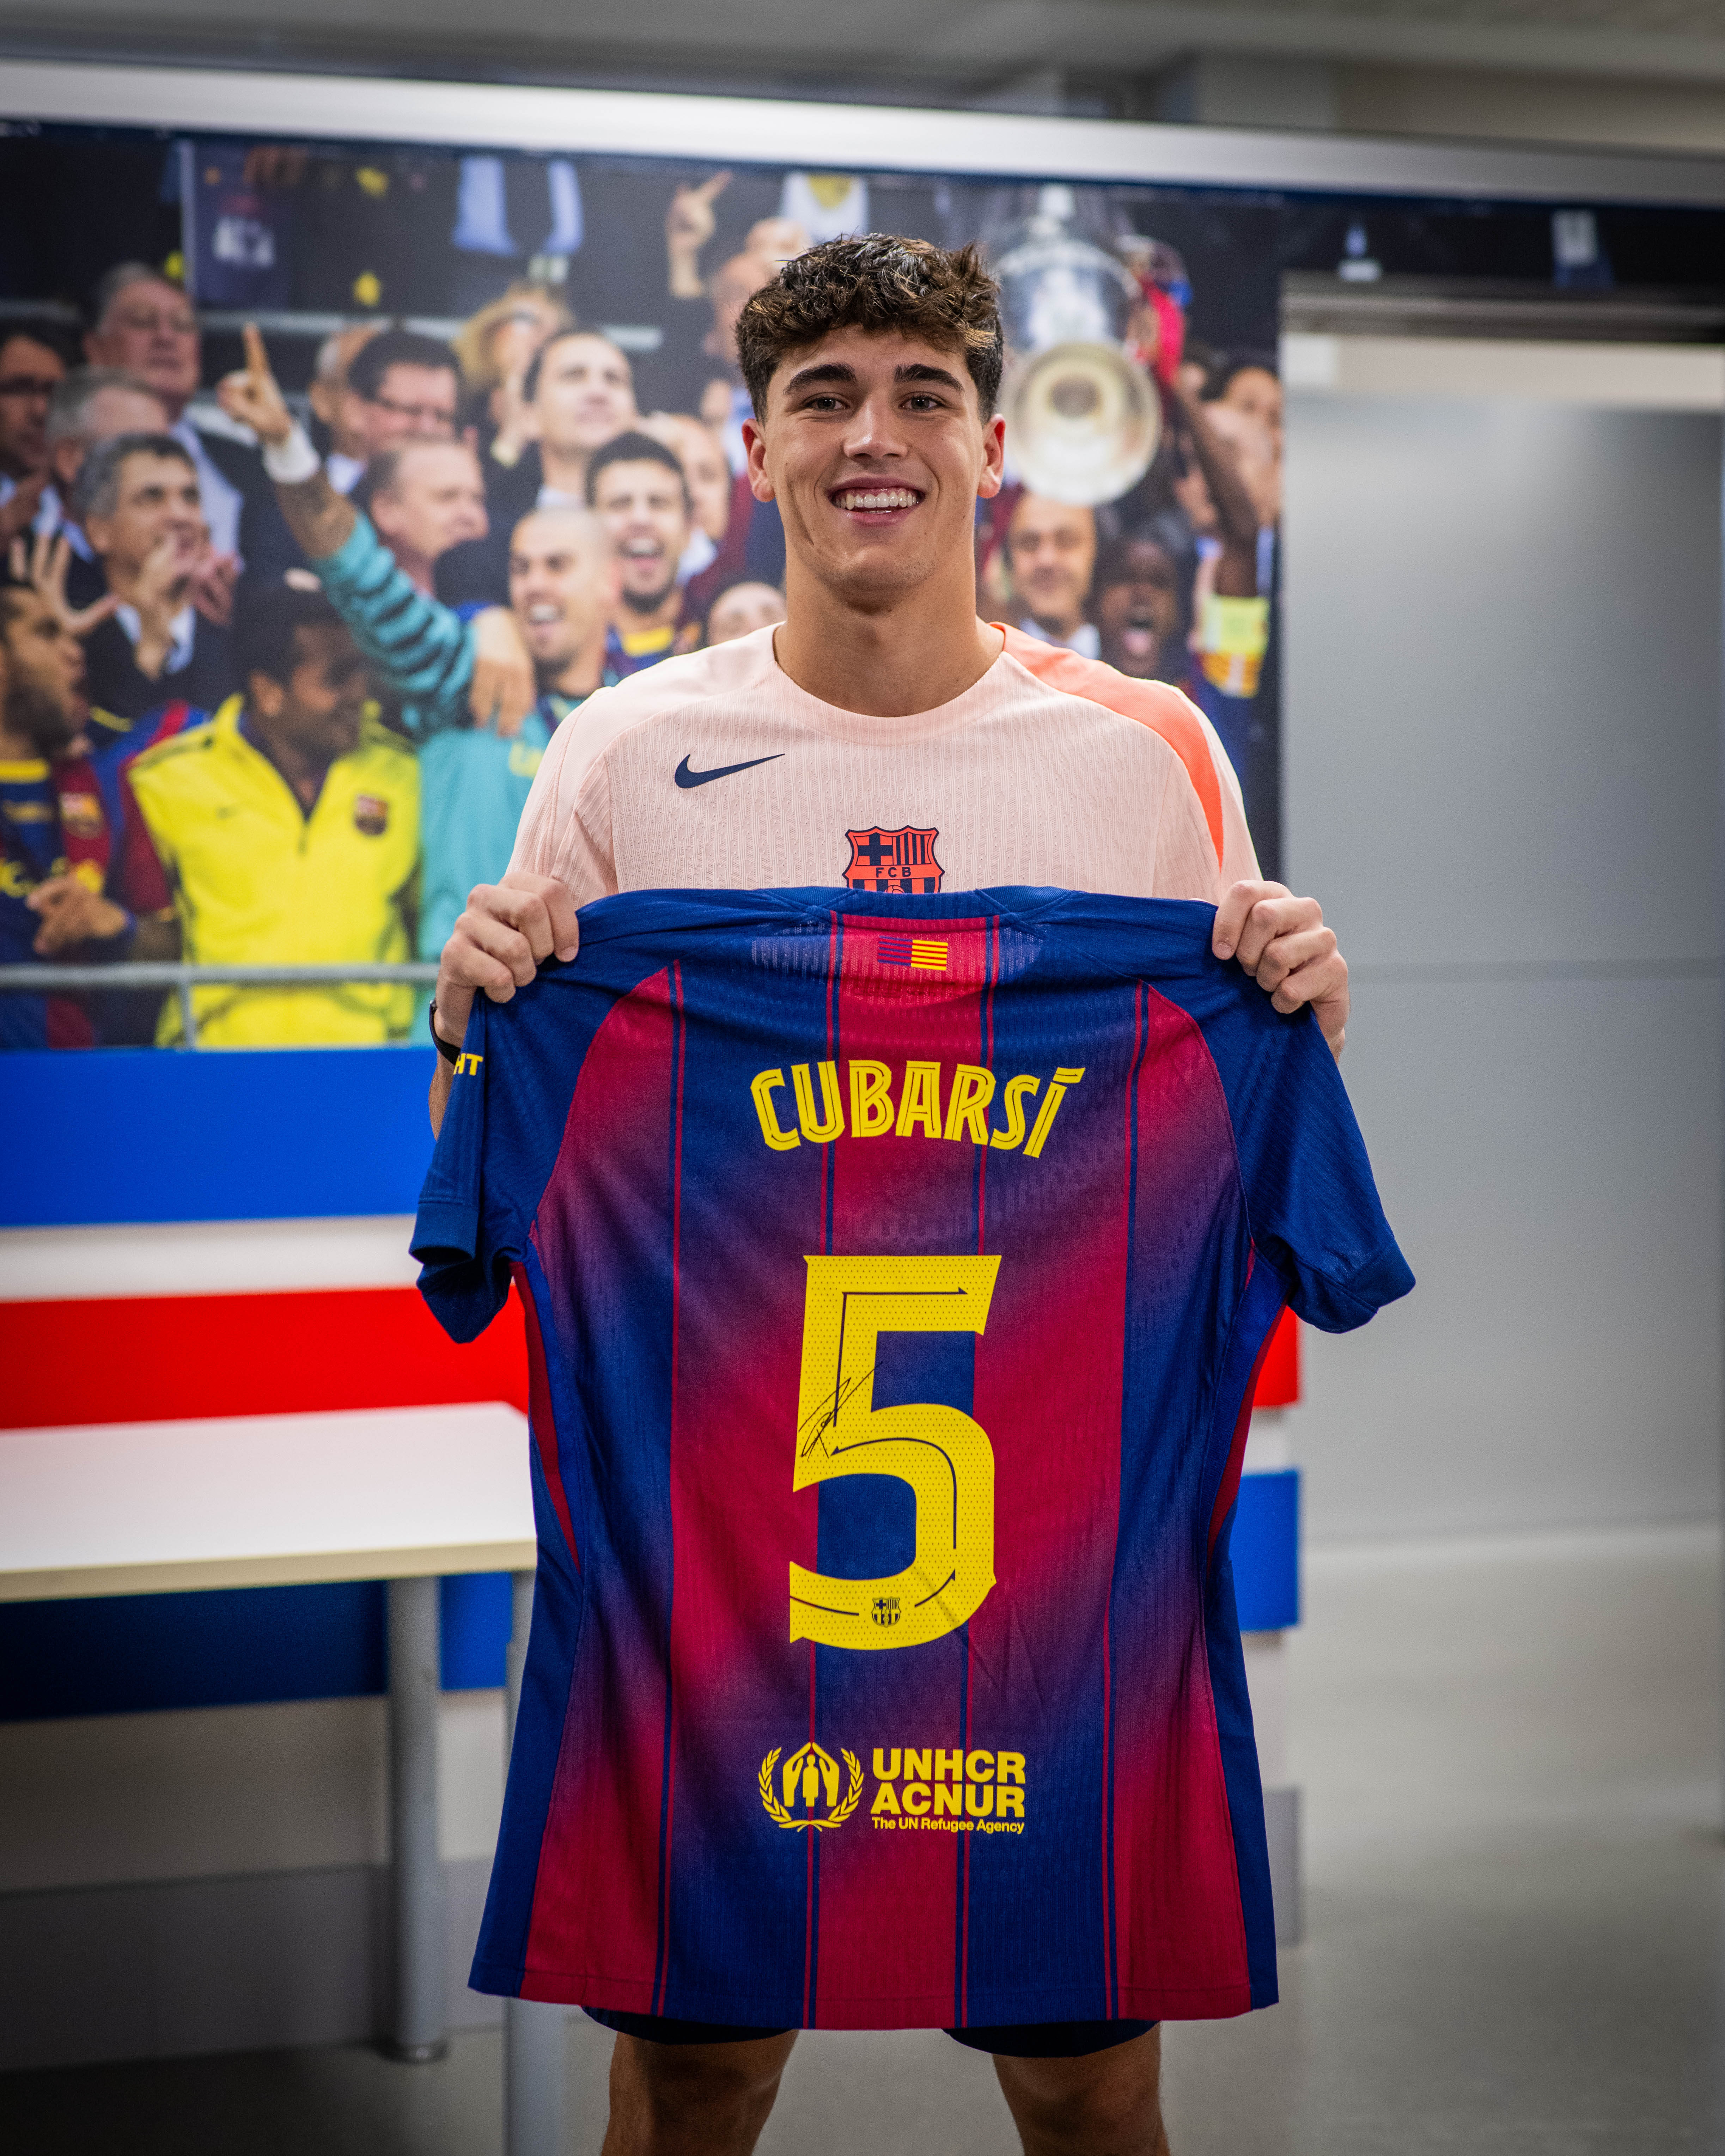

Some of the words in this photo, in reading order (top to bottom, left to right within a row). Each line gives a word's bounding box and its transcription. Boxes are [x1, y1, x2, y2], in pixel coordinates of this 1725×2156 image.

[876, 866, 912, 878] FCB
[750, 1059, 1086, 1159] CUBARSÍ
[789, 1254, 1002, 1650] 5
[873, 1748, 1026, 1784] UNHCR
[870, 1782, 1025, 1818] ACNUR
[872, 1816, 896, 1830] The
[898, 1817, 918, 1830] UN
[921, 1818, 974, 1833] Refugee
[976, 1819, 1024, 1834] Agency
